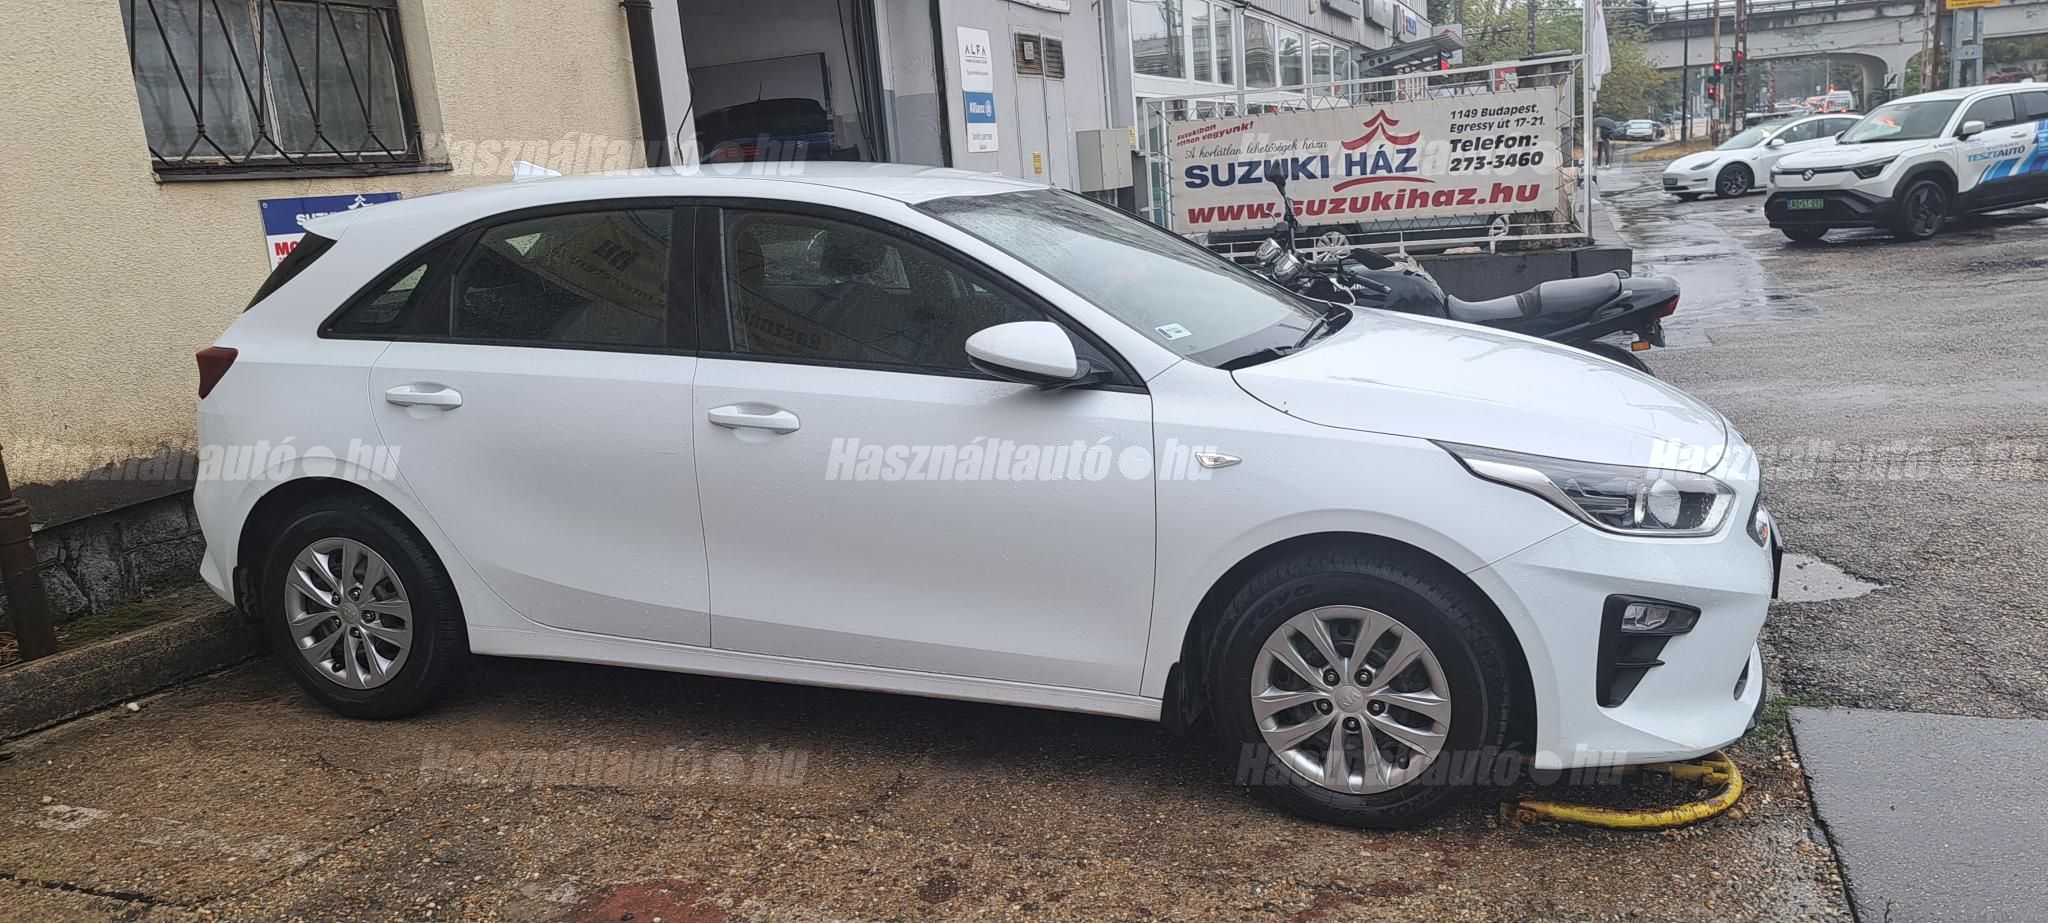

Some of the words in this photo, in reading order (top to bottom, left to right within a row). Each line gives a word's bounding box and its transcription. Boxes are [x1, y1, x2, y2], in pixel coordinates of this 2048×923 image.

[1450, 108, 1478, 119] 1149
[1481, 103, 1540, 117] Budapest,
[1202, 121, 1255, 140] vagyunk!
[1449, 120, 1494, 133] Egressy
[1497, 118, 1511, 129] út
[1514, 116, 1545, 127] 17-21.
[1199, 144, 1243, 159] korlátlan
[1246, 138, 1301, 156] lehetőségek
[1302, 137, 1328, 151] háza
[1450, 134, 1539, 153] Telefon:
[1184, 154, 1330, 189] SUZUKI
[1344, 144, 1419, 177] HÁZ
[1449, 151, 1544, 172] 273-3460
[1187, 183, 1541, 225] www.suzukihaz.hu
